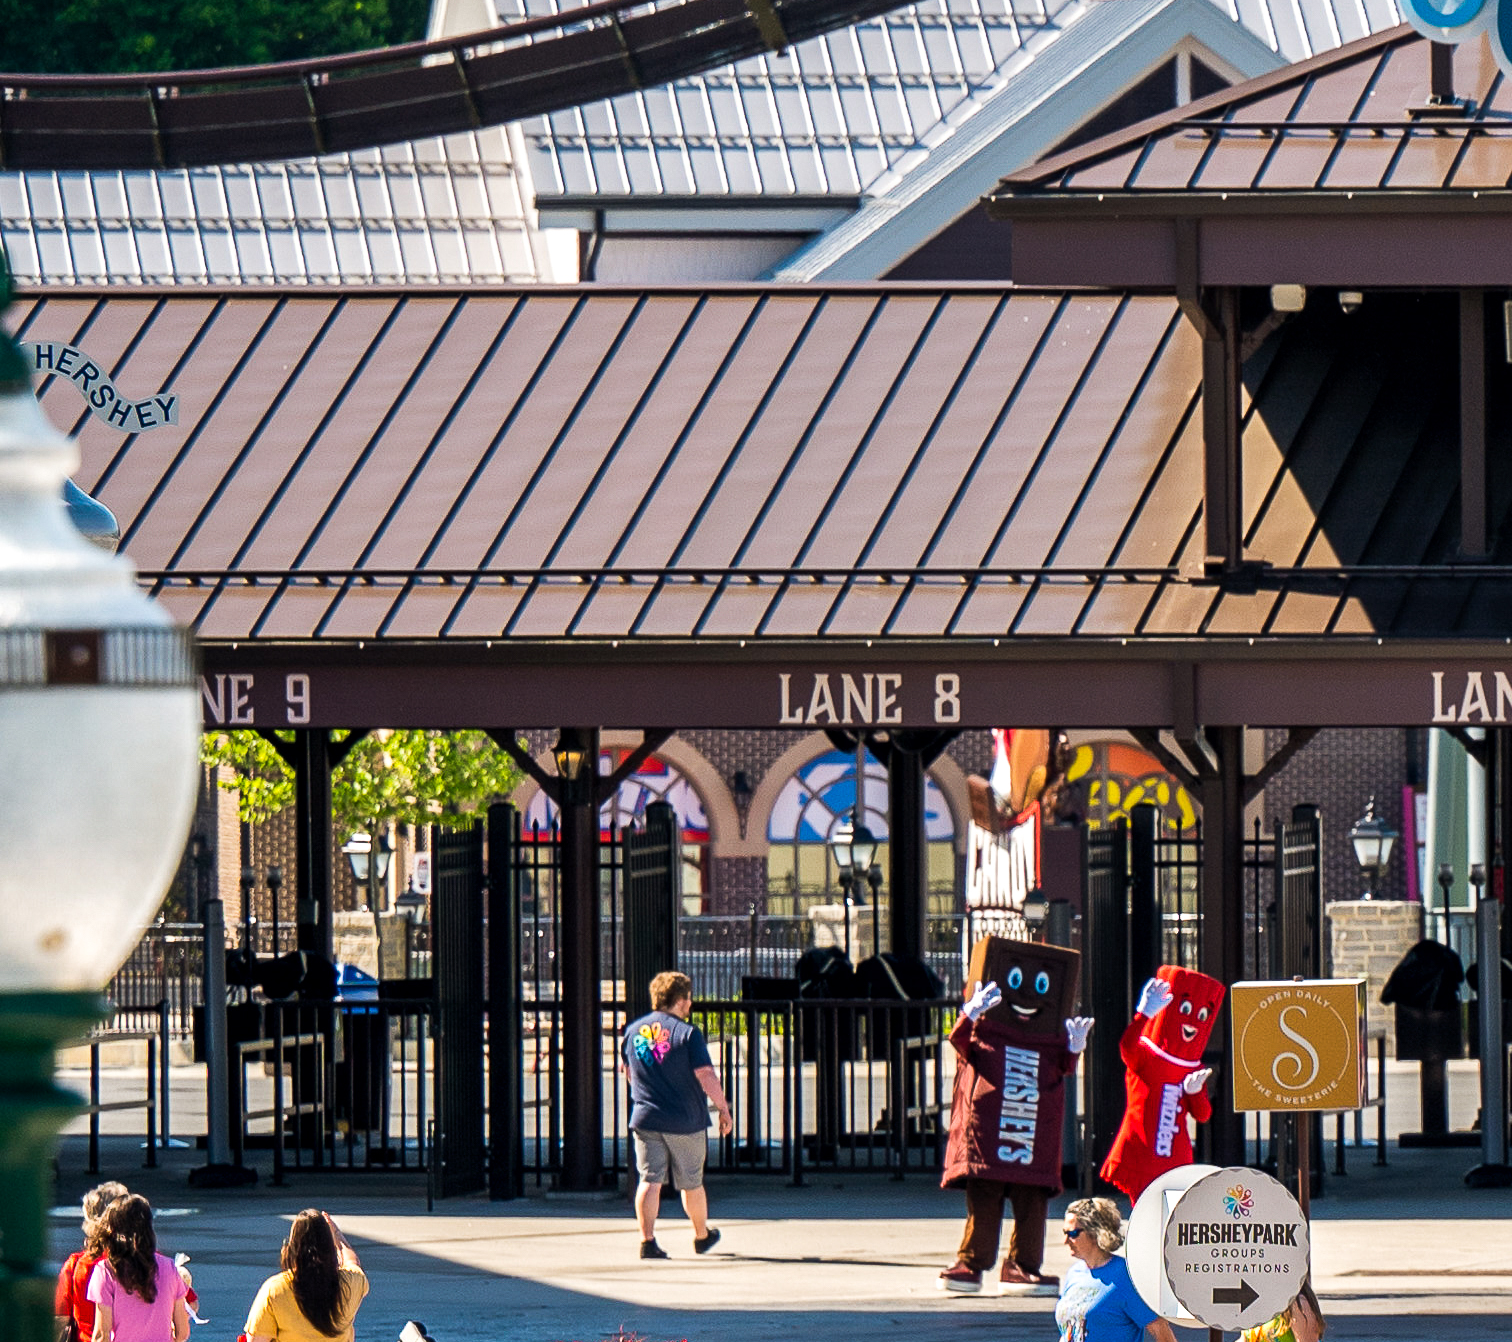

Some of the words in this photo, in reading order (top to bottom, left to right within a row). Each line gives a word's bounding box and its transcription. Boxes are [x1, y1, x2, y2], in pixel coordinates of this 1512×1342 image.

[36, 344, 176, 428] HERSHEY
[199, 673, 254, 724] NE
[286, 673, 310, 724] 9
[779, 673, 902, 724] LANE
[934, 673, 960, 723] 8
[1259, 990, 1291, 1009] OPEN
[1296, 989, 1331, 1008] DAILY
[1272, 1005, 1320, 1090] S
[1252, 1079, 1272, 1097] THE
[1275, 1080, 1339, 1105] SWEETERIE
[1177, 1222, 1298, 1247] HERSHEYPARK
[1210, 1248, 1265, 1258] GROUPS
[1185, 1263, 1290, 1273] REGISTRATIONS
